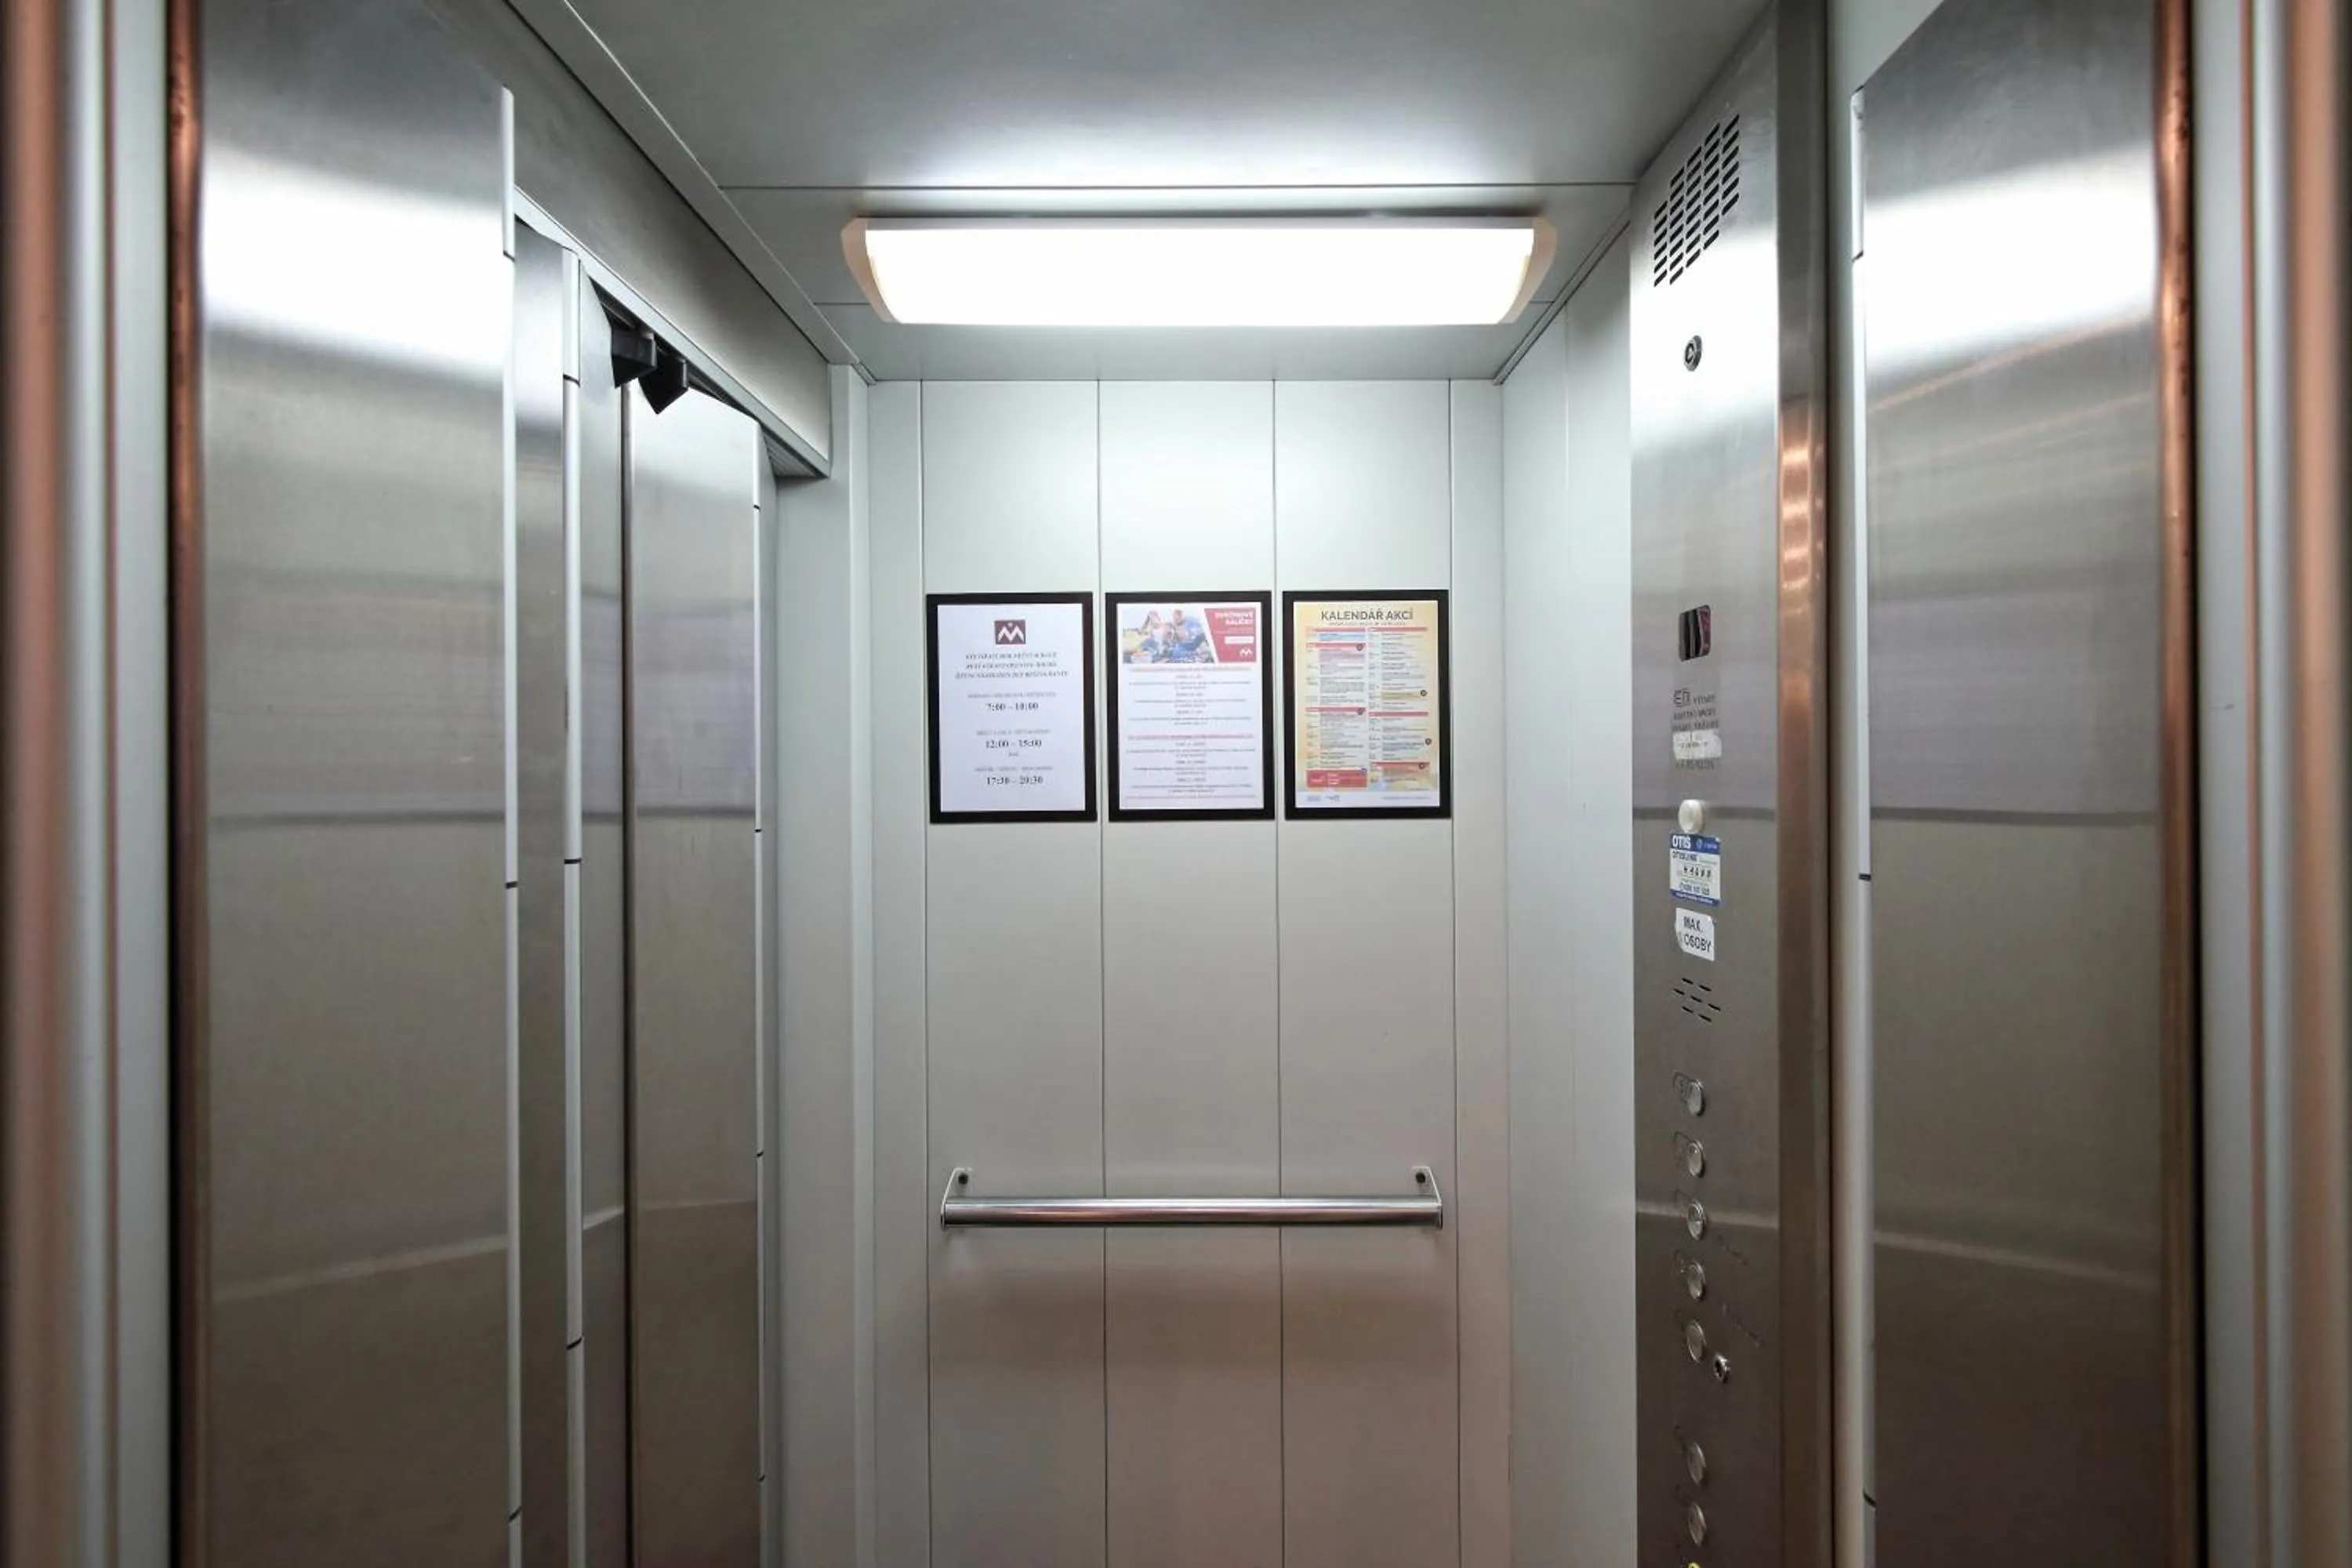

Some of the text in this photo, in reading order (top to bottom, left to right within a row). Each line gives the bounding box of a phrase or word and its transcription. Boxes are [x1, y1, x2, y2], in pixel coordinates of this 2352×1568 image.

[1321, 608, 1414, 620] KALENDÁŘ AKCÍ
[1672, 835, 1691, 849] OTIS
[1683, 934, 1711, 953] OSOBY
